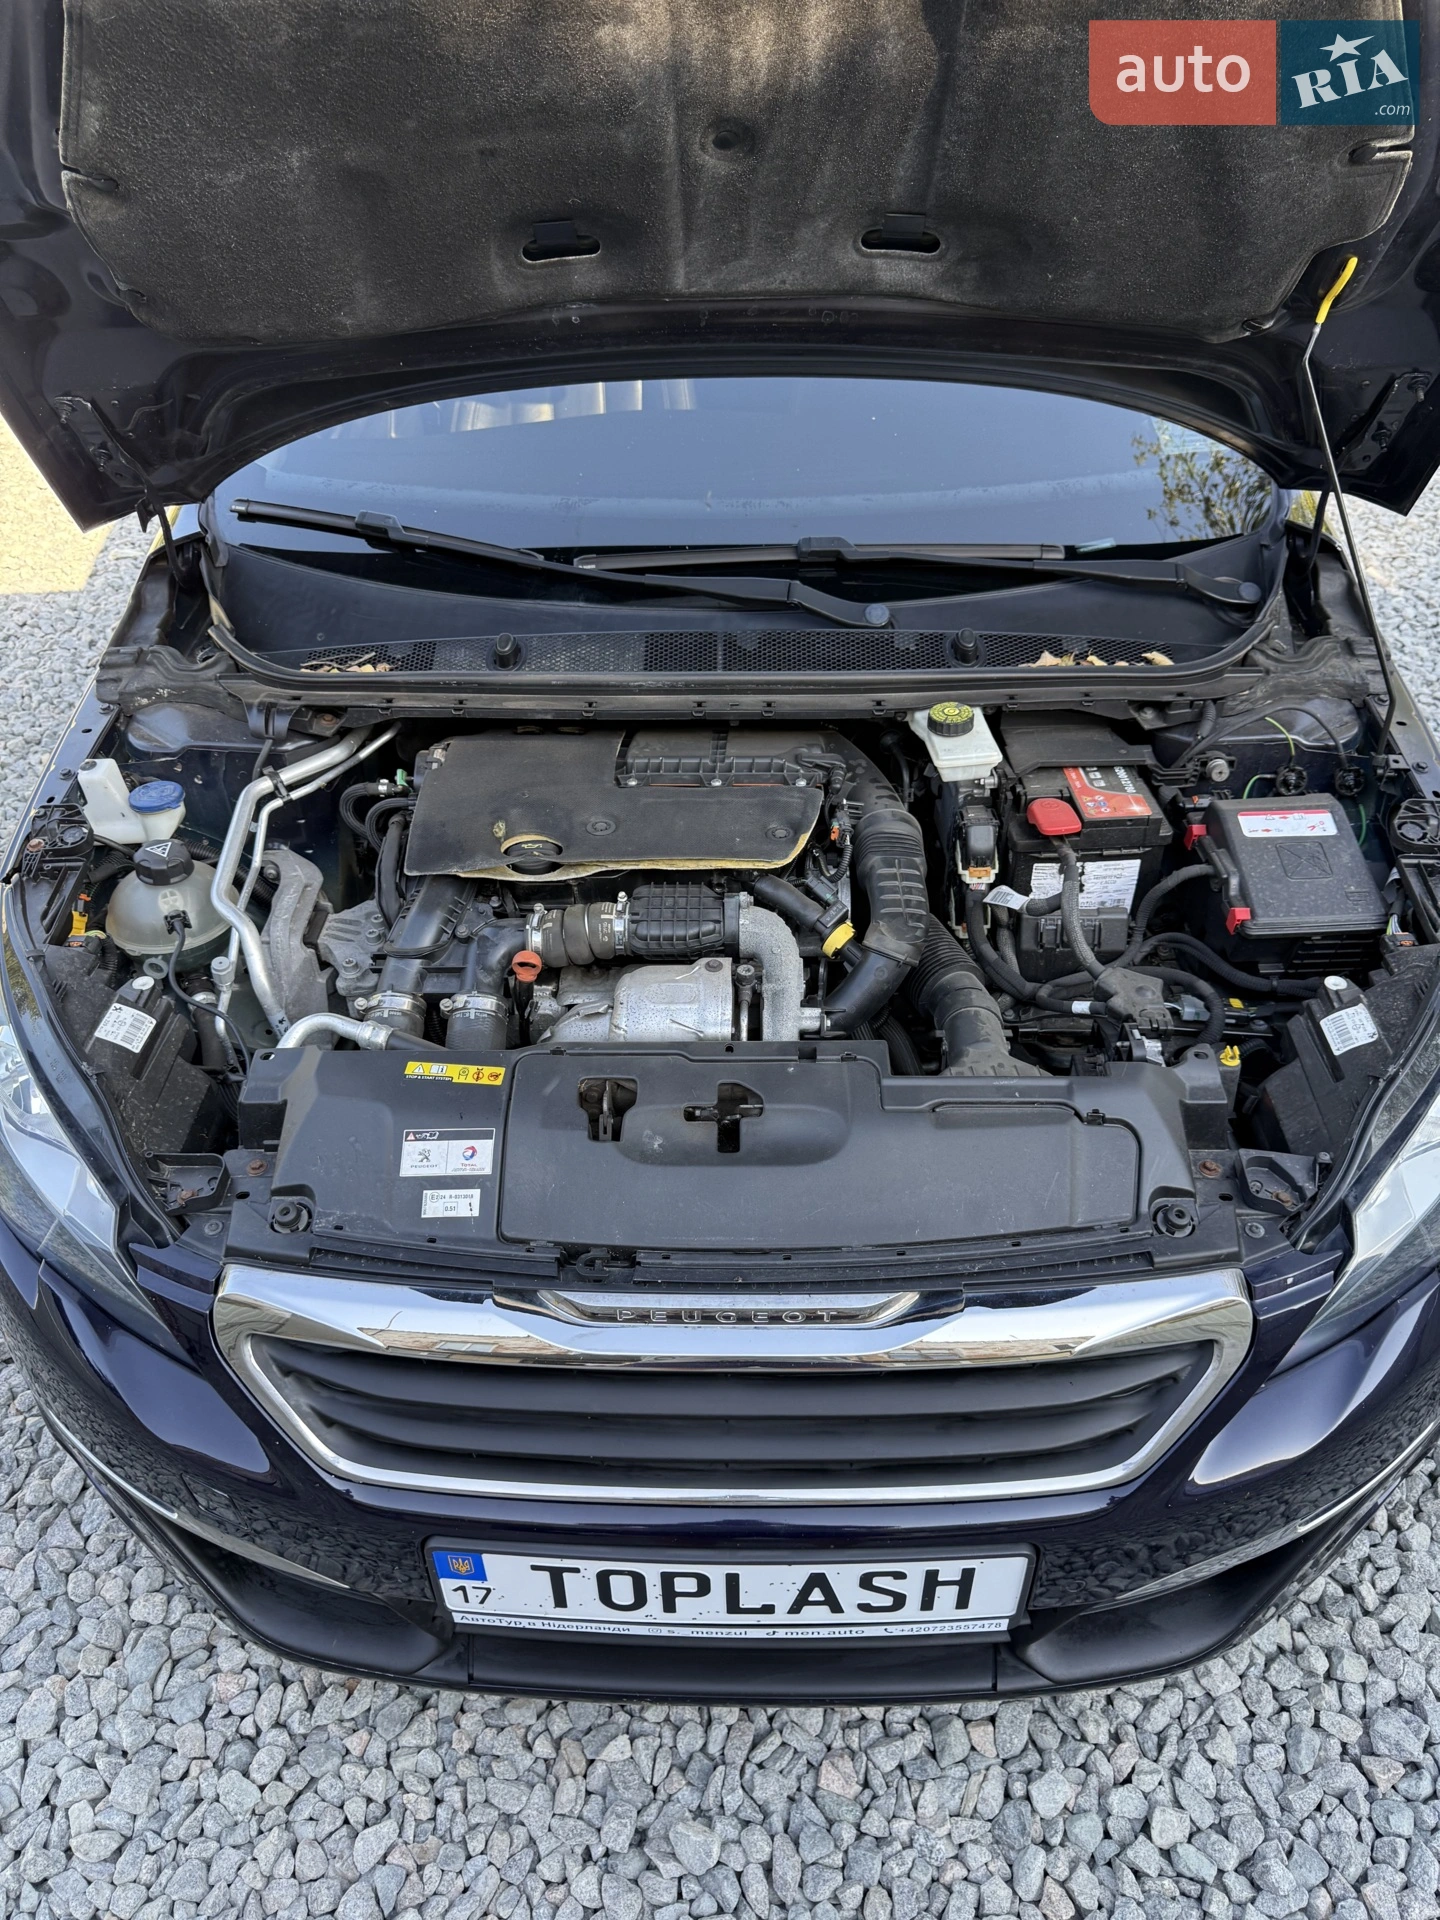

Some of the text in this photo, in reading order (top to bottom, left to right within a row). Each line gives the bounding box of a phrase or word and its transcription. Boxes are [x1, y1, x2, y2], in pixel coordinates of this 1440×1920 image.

[616, 1310, 838, 1323] PEUGEOT
[452, 1585, 491, 1605] 17
[531, 1565, 975, 1614] TOPLASH
[460, 1615, 524, 1626] АвтоТур
[541, 1621, 630, 1633] Нідерланди
[898, 1621, 1002, 1633] +420723557478
[784, 1628, 865, 1637] men.auto
